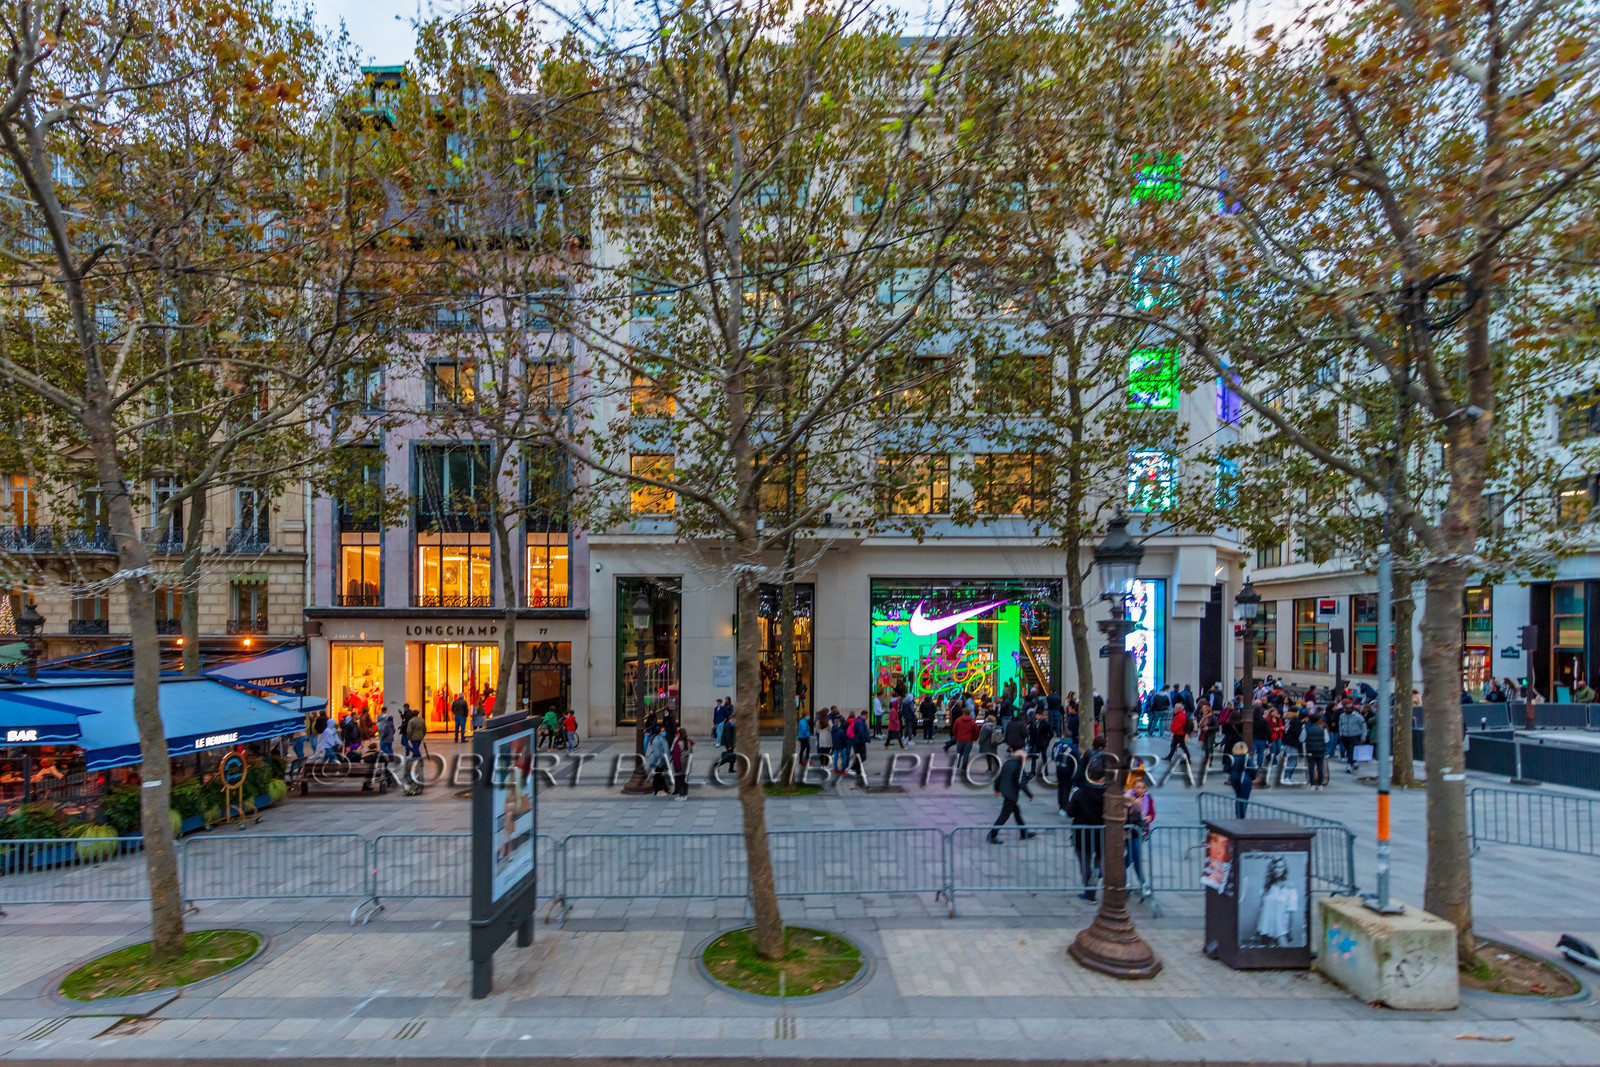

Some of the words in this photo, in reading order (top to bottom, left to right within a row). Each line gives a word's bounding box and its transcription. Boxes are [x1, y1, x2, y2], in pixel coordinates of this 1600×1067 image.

[406, 625, 498, 636] LONGCHAMP
[539, 627, 548, 636] 77
[7, 729, 38, 742] BAR
[195, 737, 205, 749] LE
